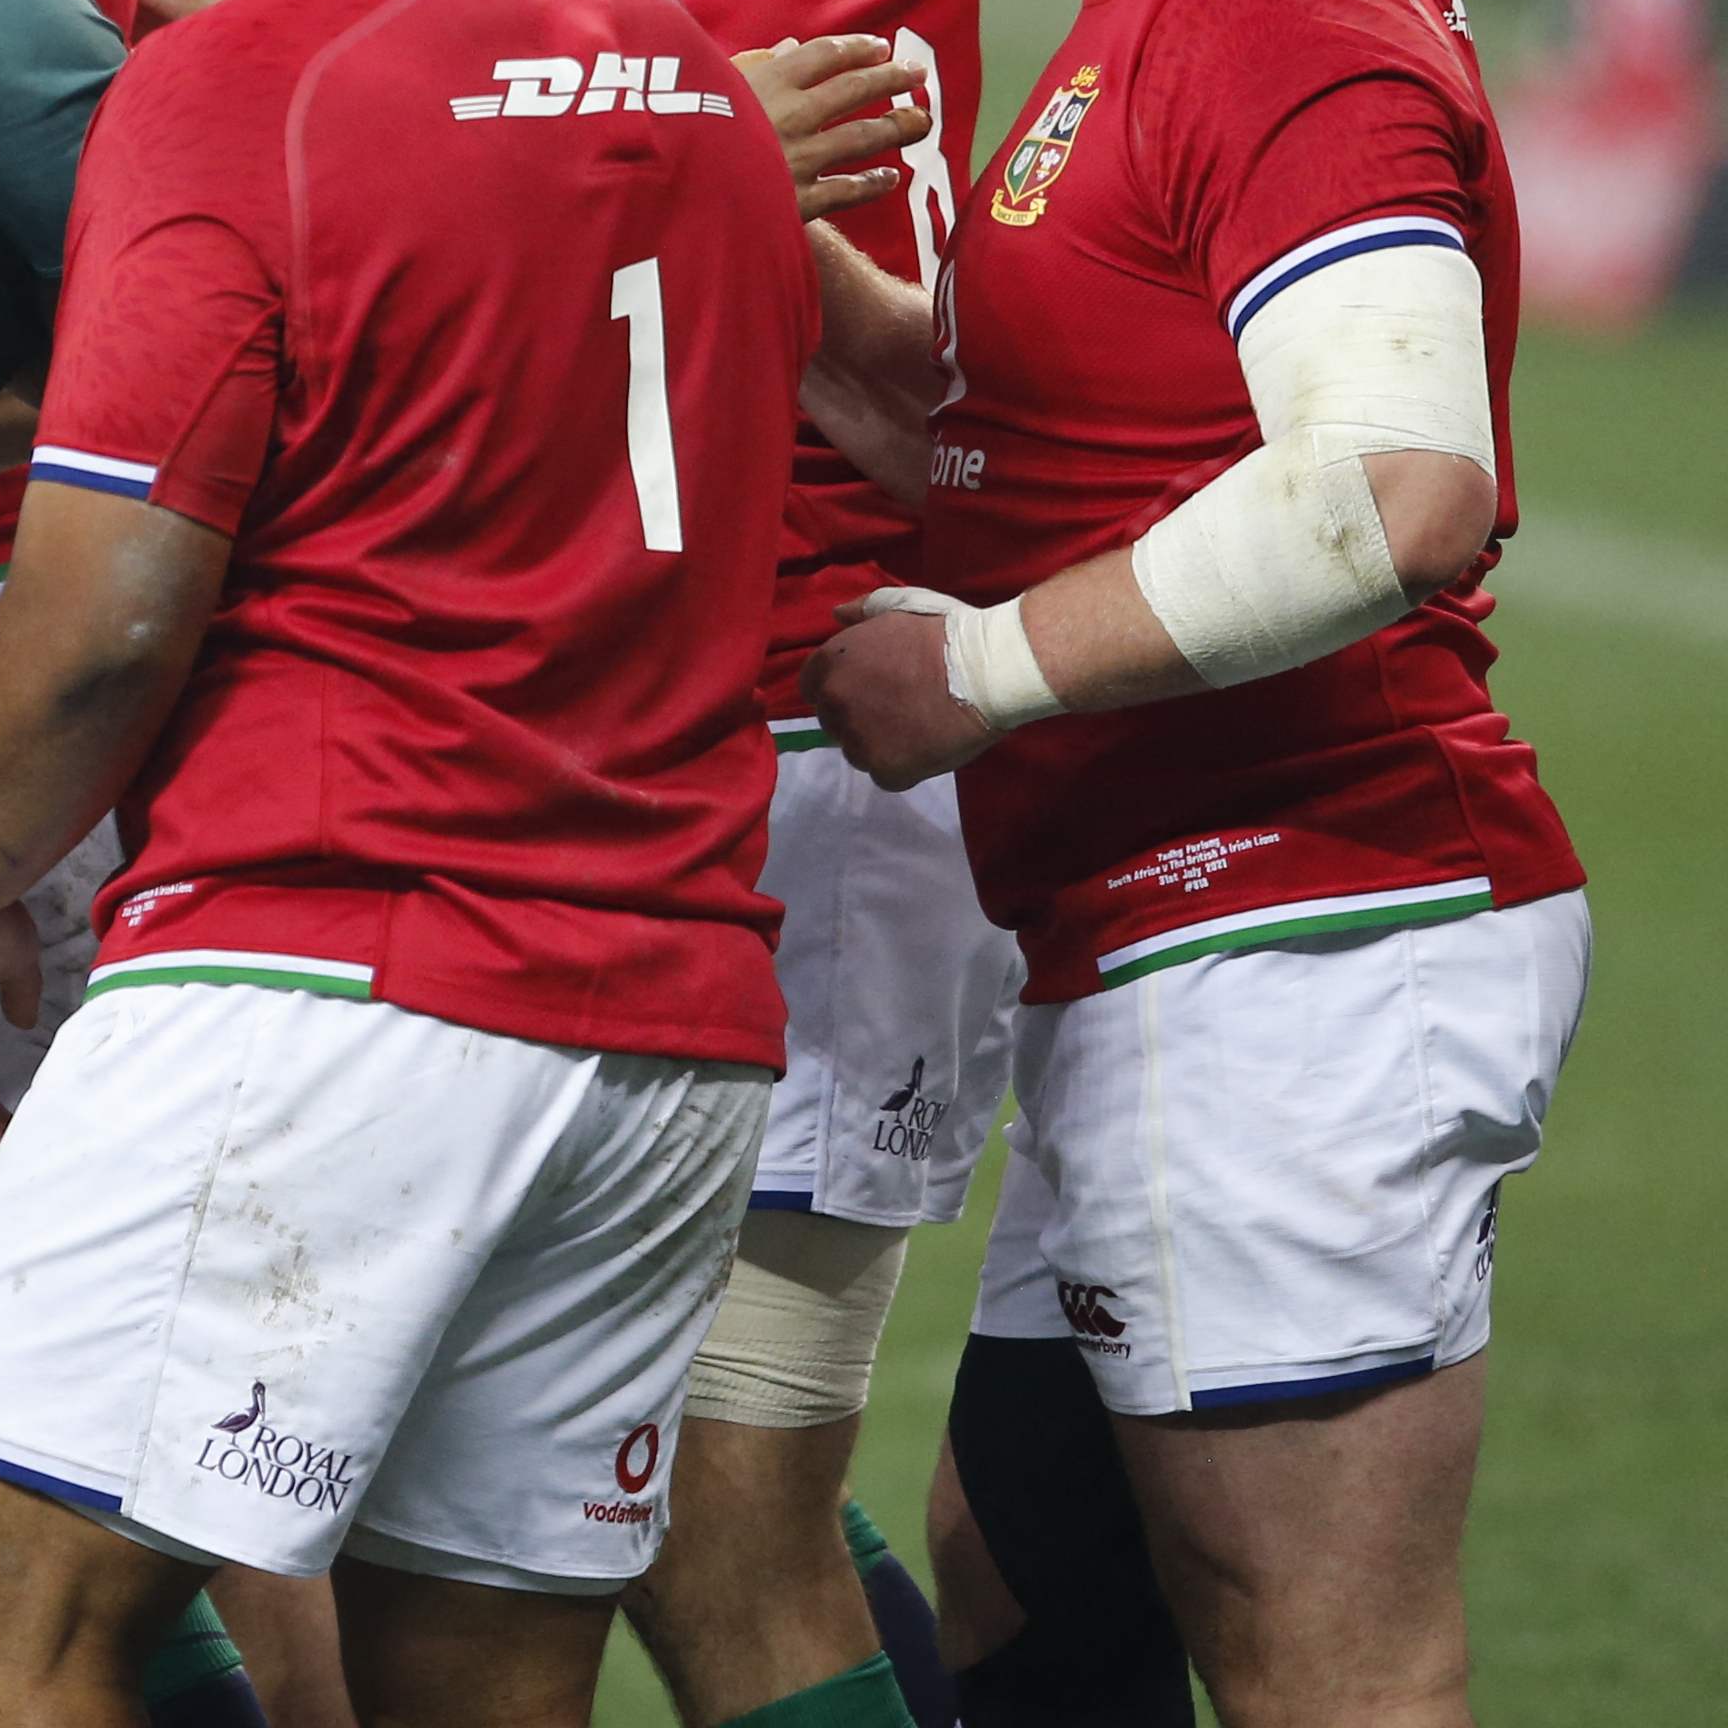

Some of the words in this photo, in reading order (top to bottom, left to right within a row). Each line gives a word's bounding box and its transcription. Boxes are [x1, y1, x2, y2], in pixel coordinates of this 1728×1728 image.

[492, 51, 702, 117] DHL
[610, 256, 683, 553] 1
[1229, 838, 1253, 854] Irish
[194, 1437, 349, 1515] LONDON
[249, 1424, 354, 1486] ROYAL
